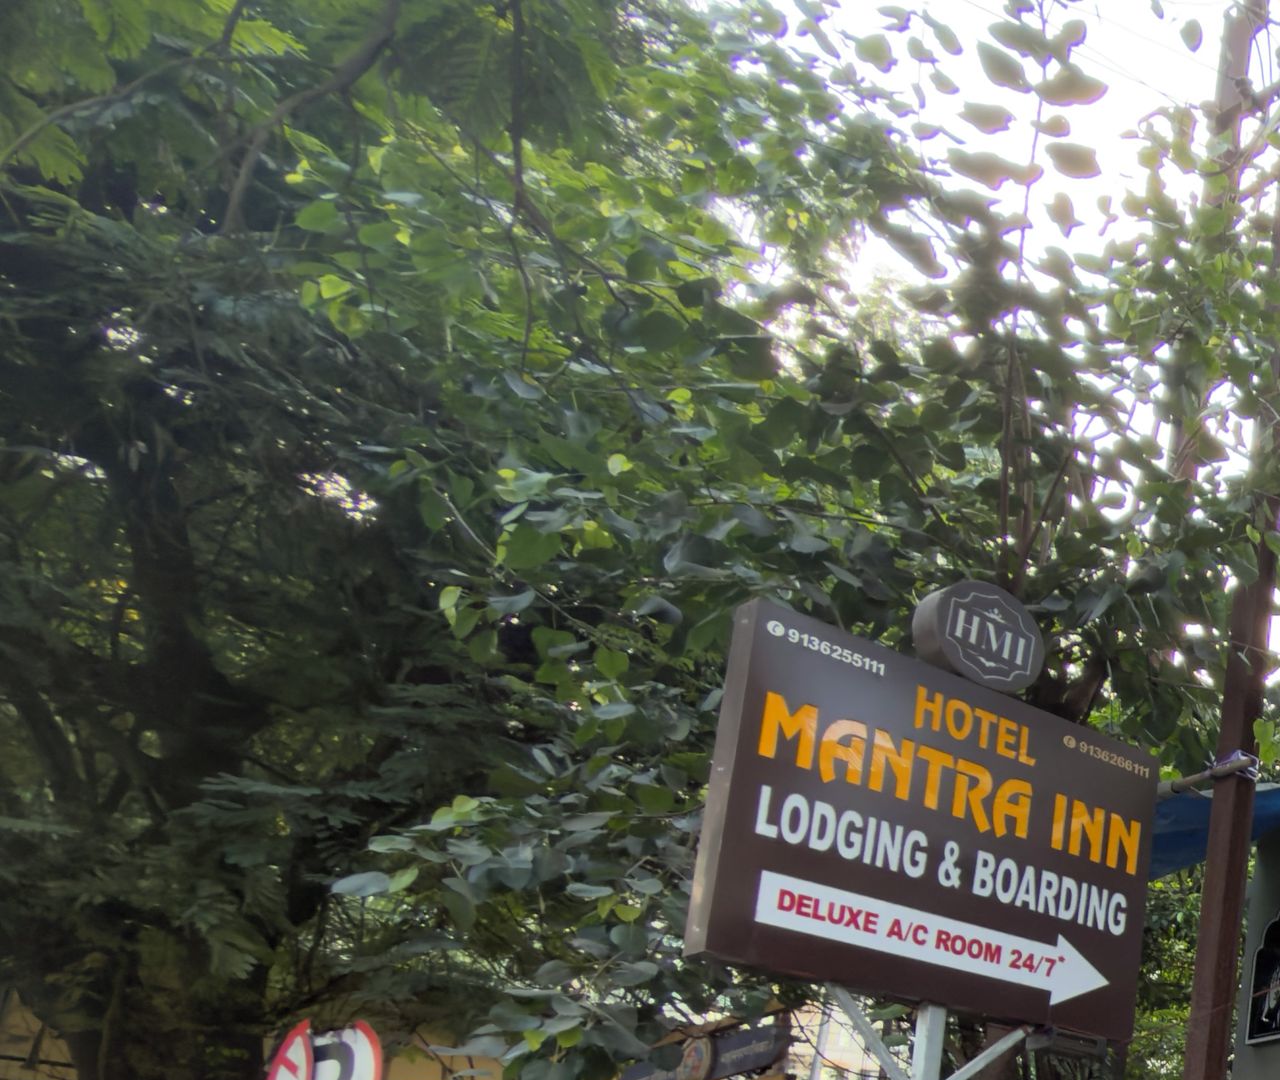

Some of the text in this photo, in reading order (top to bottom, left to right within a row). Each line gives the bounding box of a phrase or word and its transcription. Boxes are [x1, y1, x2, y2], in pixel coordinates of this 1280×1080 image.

[788, 628, 886, 677] 9136255111
[954, 608, 1026, 666] HMI
[914, 685, 1036, 767] HOTEL
[1079, 741, 1150, 779] 9136266111
[758, 691, 1142, 876] MANTRA INN
[755, 785, 1127, 936] LODGING & BOARDING
[777, 888, 878, 935] DELUXE
[886, 919, 928, 947] A/C
[935, 930, 1001, 965] ROOM
